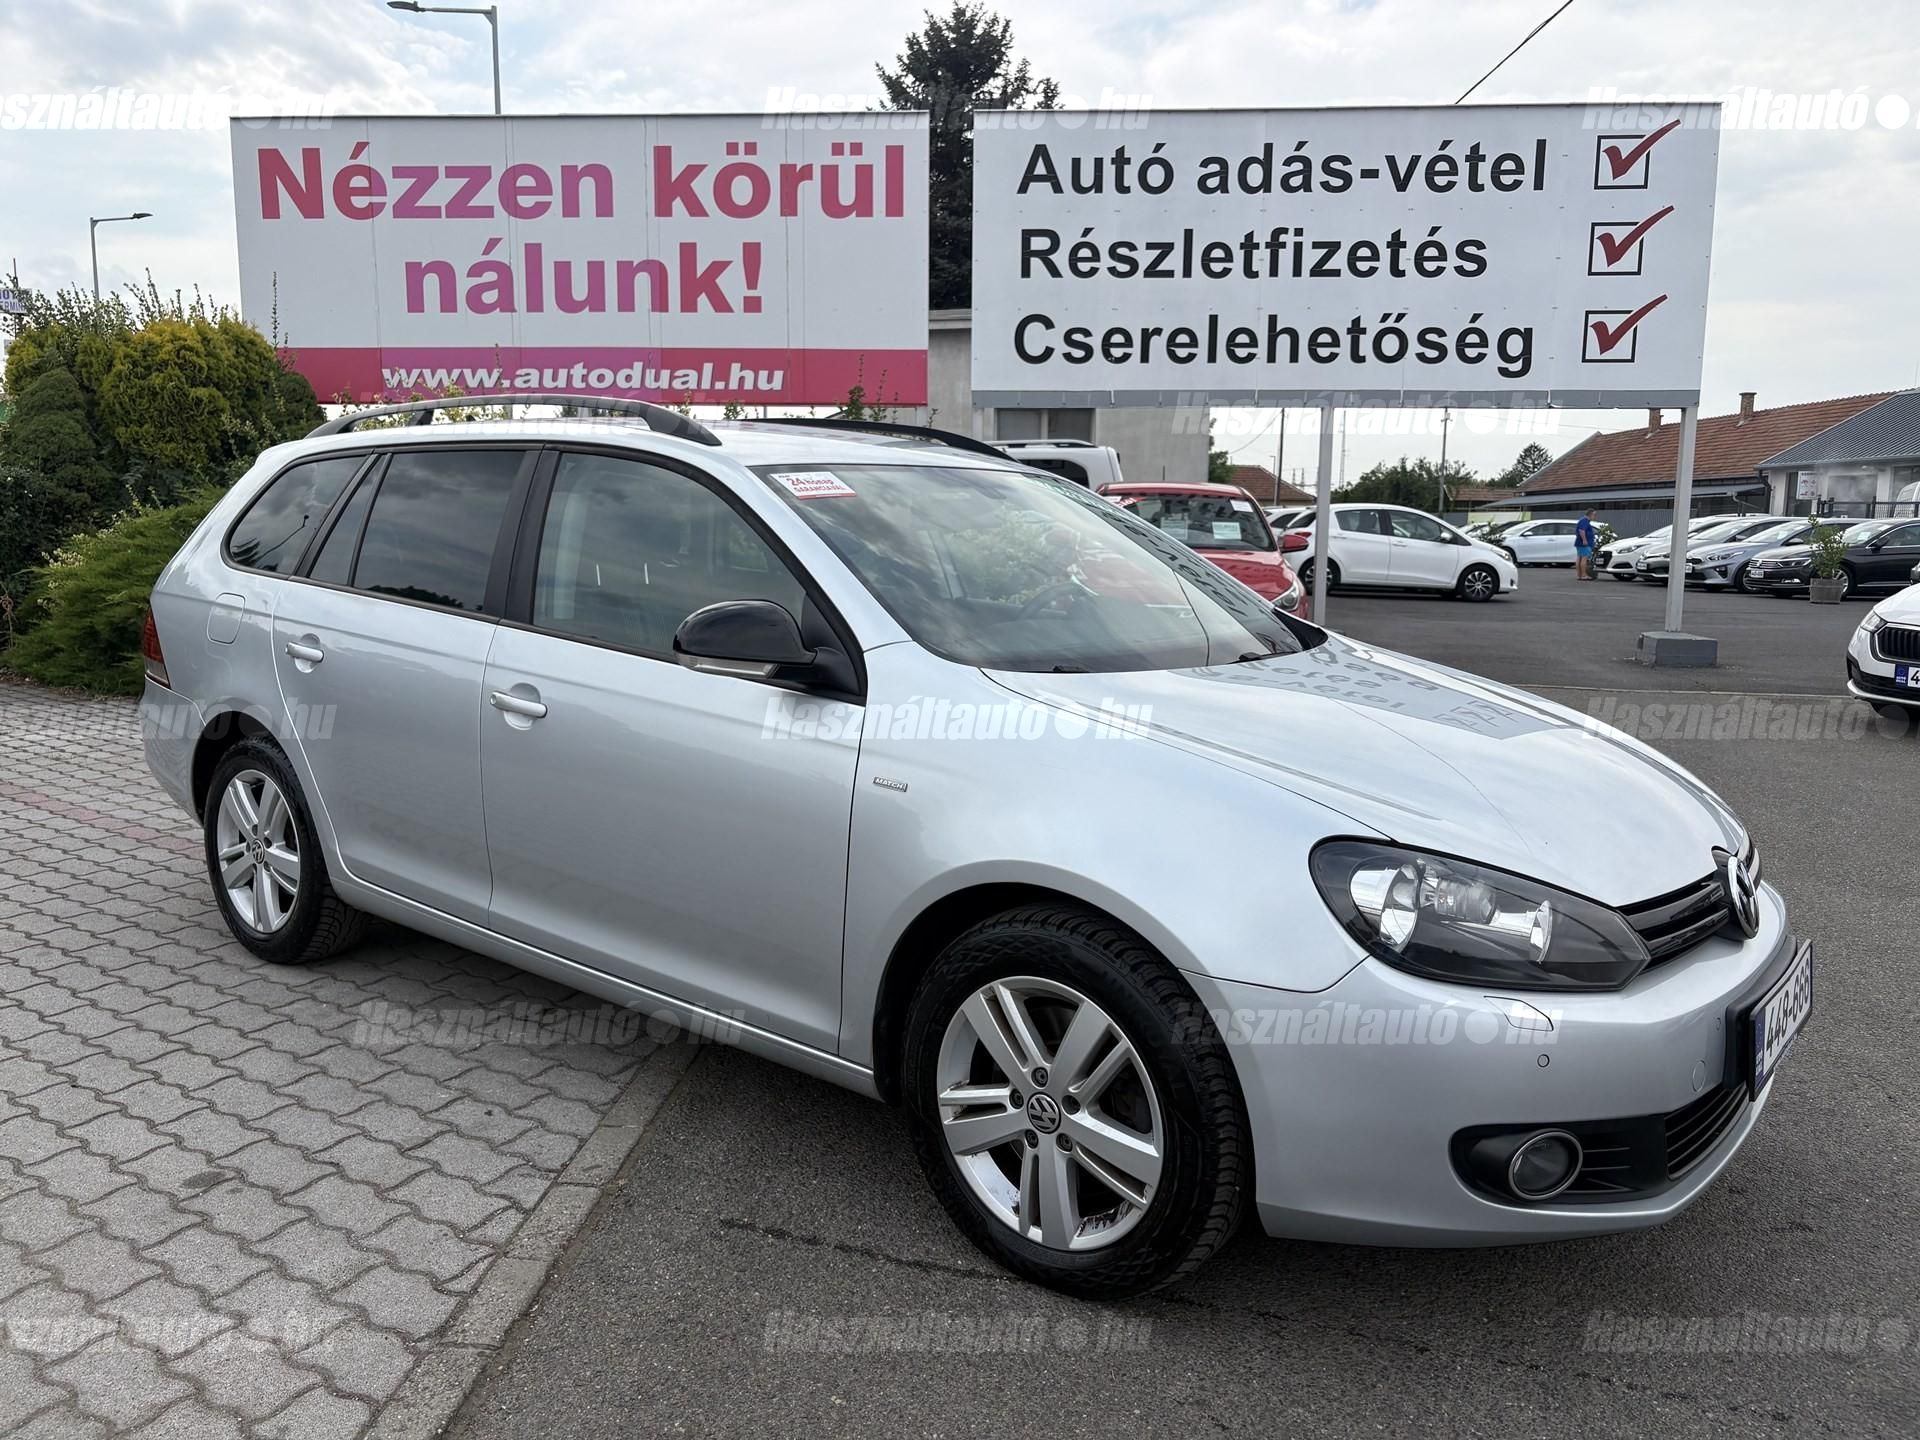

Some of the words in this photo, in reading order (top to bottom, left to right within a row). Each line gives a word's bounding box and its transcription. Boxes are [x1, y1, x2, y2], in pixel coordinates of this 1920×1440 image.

[257, 141, 615, 221] Nézzen
[653, 141, 905, 219] körül
[1016, 142, 1175, 196] Autó
[1197, 138, 1547, 195] adás-vétel
[405, 237, 763, 315] nálunk!
[1020, 225, 1488, 280] Részletfizetés
[1013, 311, 1534, 379] Cserelehetőség
[381, 361, 785, 393] www.autodual.hu
